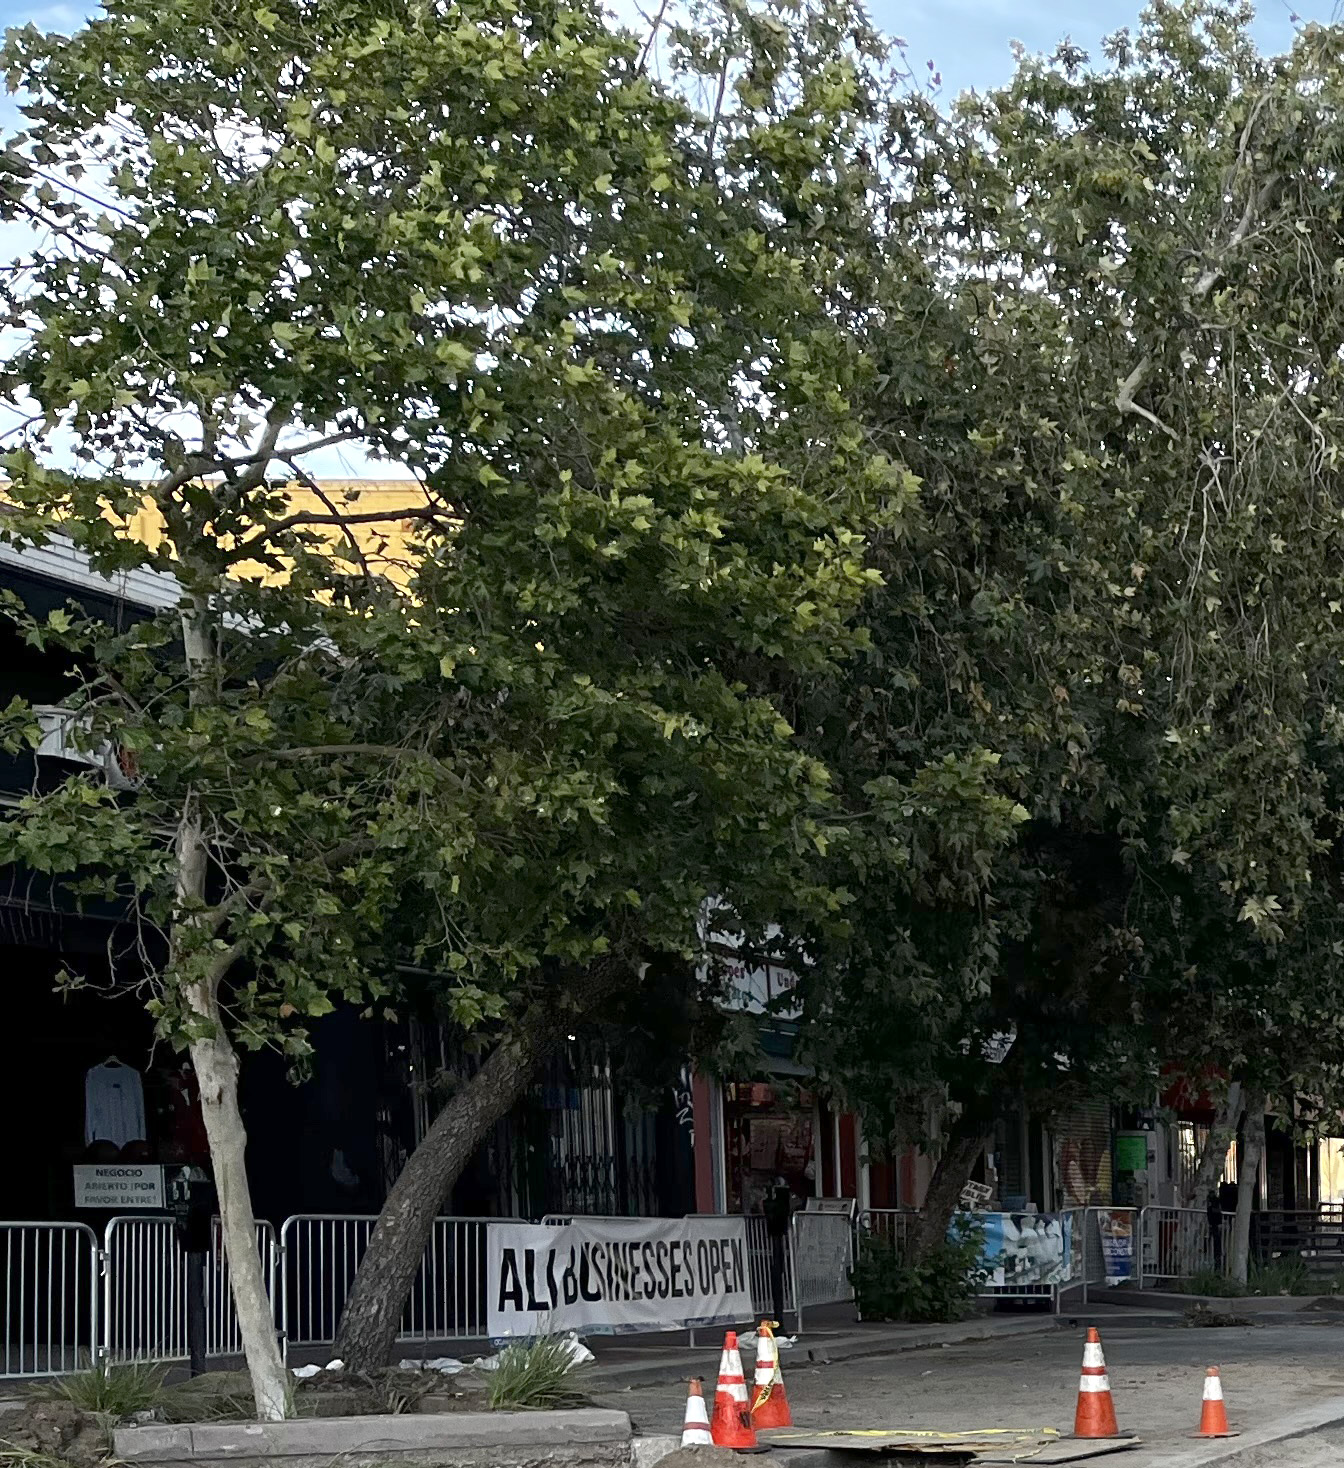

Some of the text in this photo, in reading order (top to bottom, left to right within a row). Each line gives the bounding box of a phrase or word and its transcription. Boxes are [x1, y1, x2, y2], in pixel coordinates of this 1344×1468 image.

[95, 1168, 143, 1177] NEGOCIO
[84, 1182, 128, 1191] ABIERTO
[563, 1239, 695, 1306] BUSINESSES
[697, 1238, 746, 1296] OPEN
